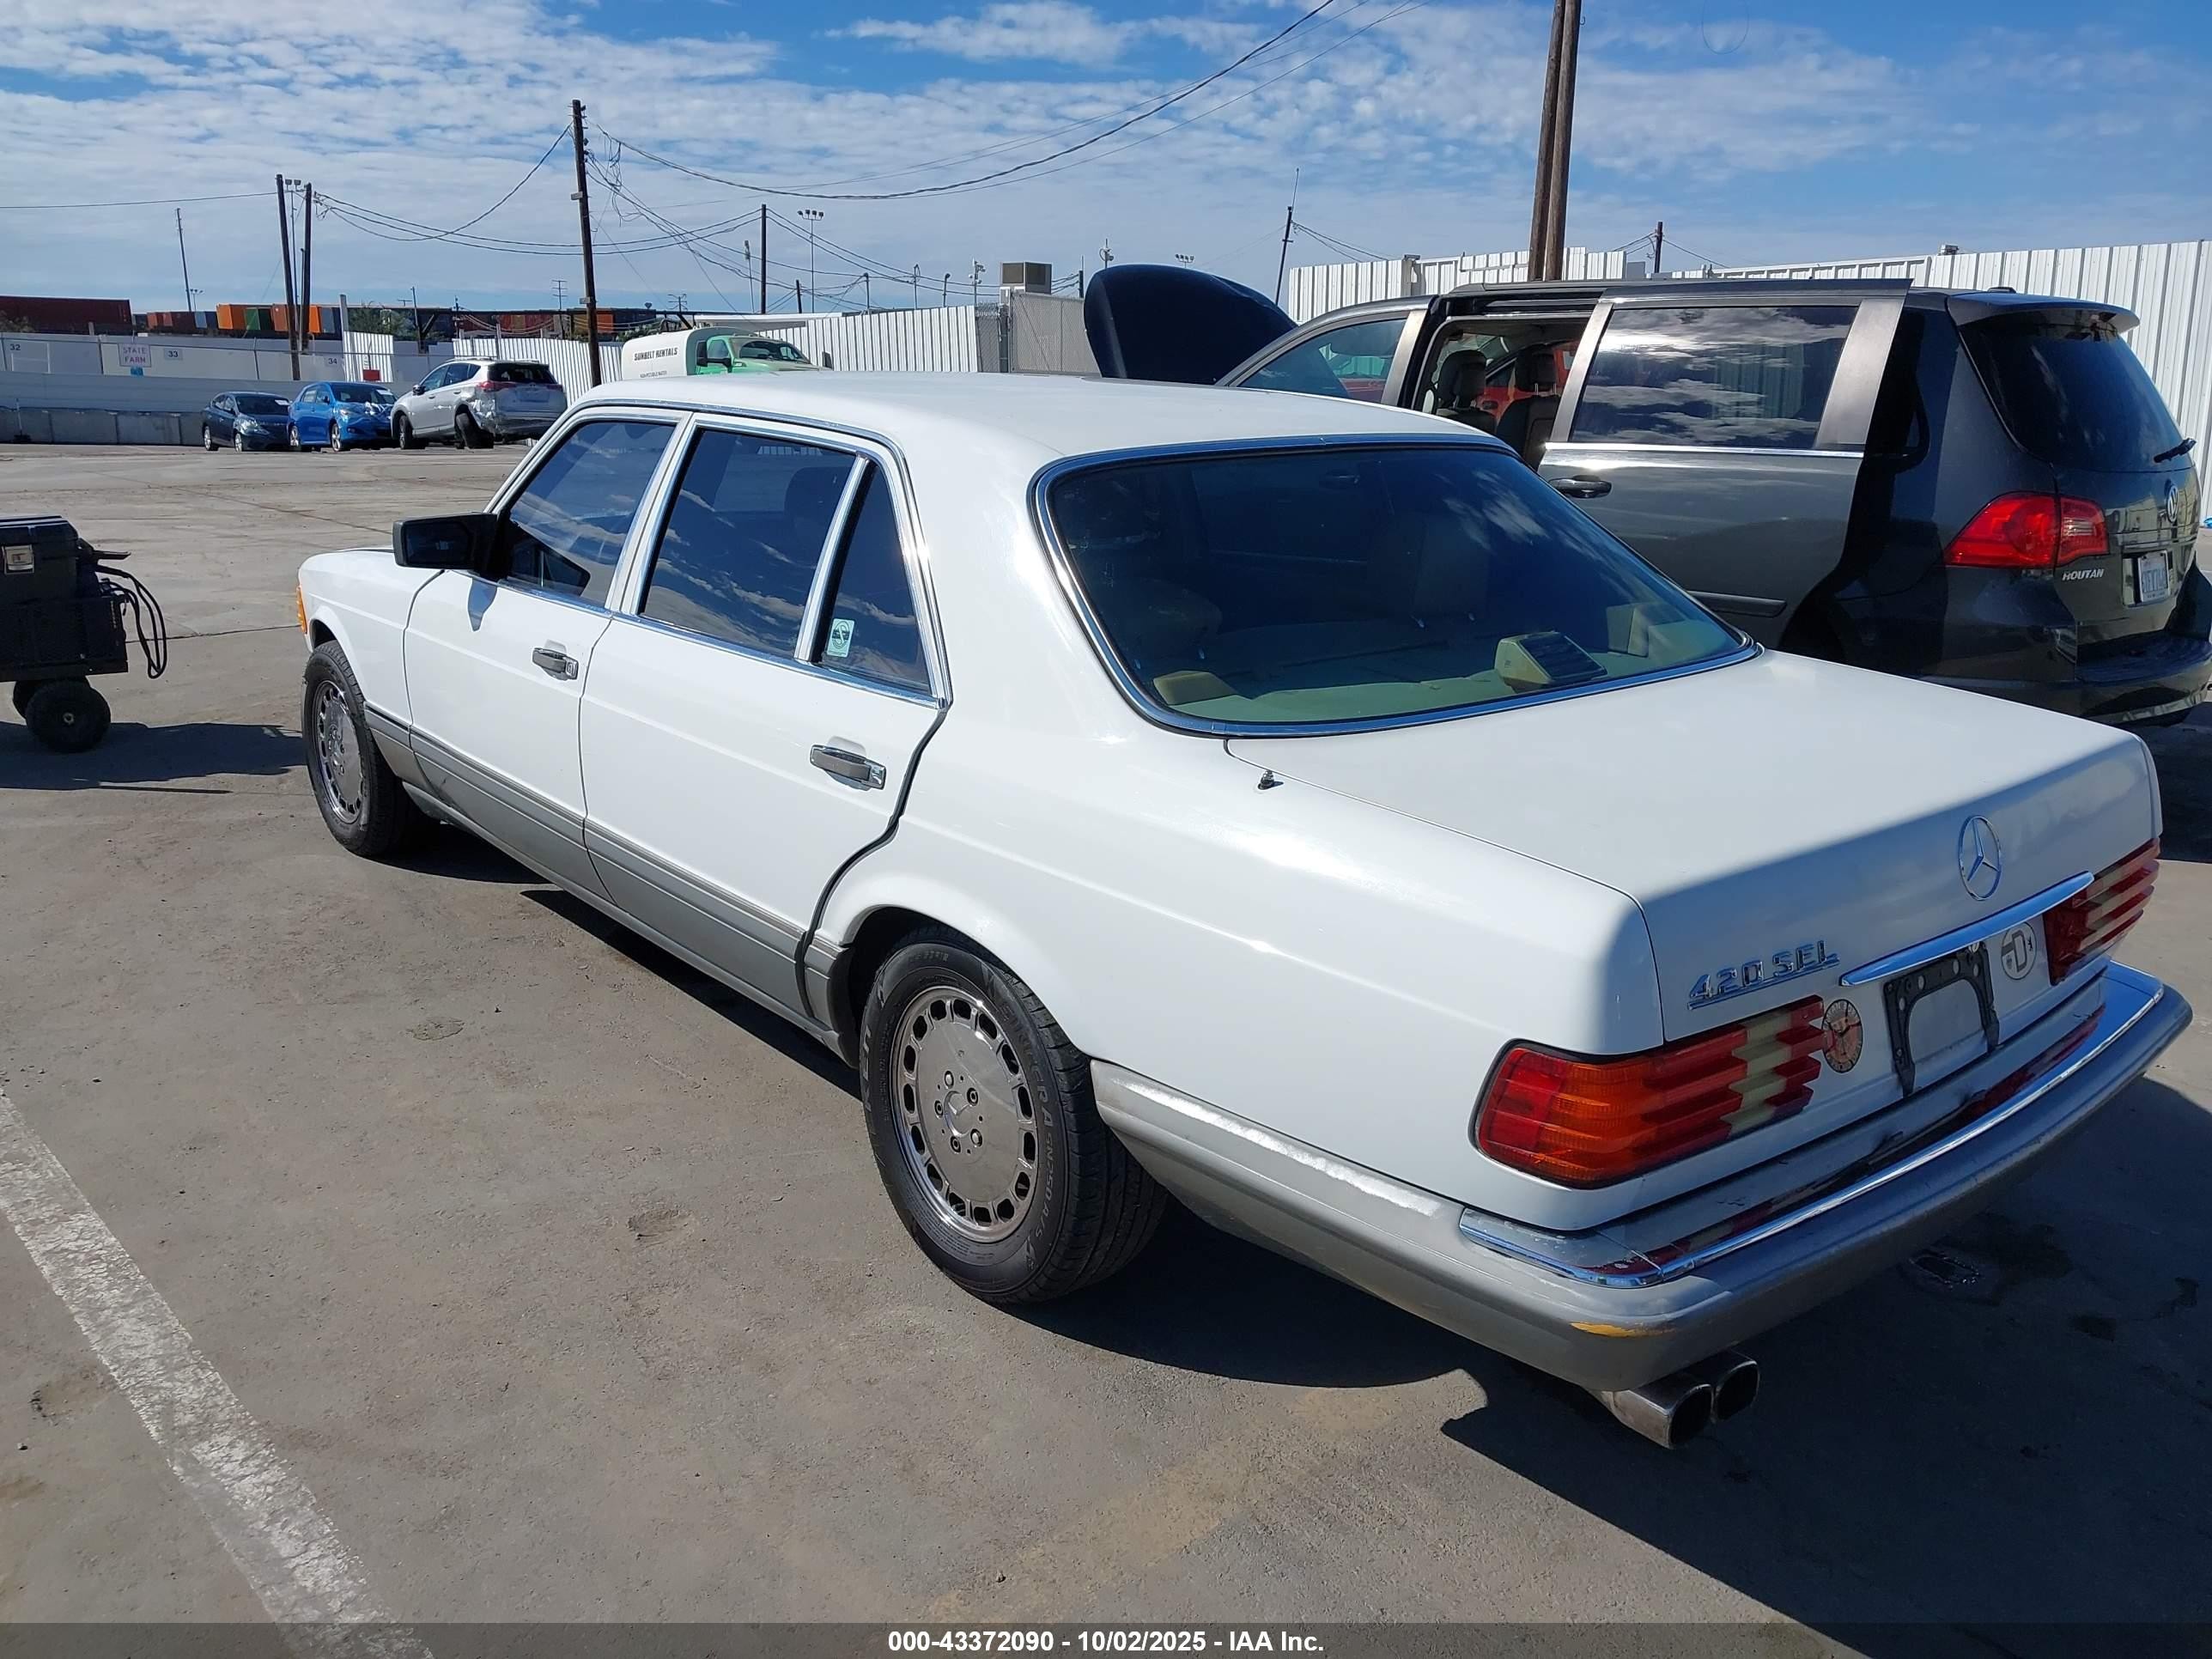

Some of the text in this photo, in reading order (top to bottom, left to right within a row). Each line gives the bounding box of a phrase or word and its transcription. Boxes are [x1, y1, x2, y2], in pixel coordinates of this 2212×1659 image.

[634, 347, 678, 361] SUNBELT RENTALS
[2062, 568, 2105, 581] ROUTAN
[1689, 940, 1839, 1000] 420 SEL
